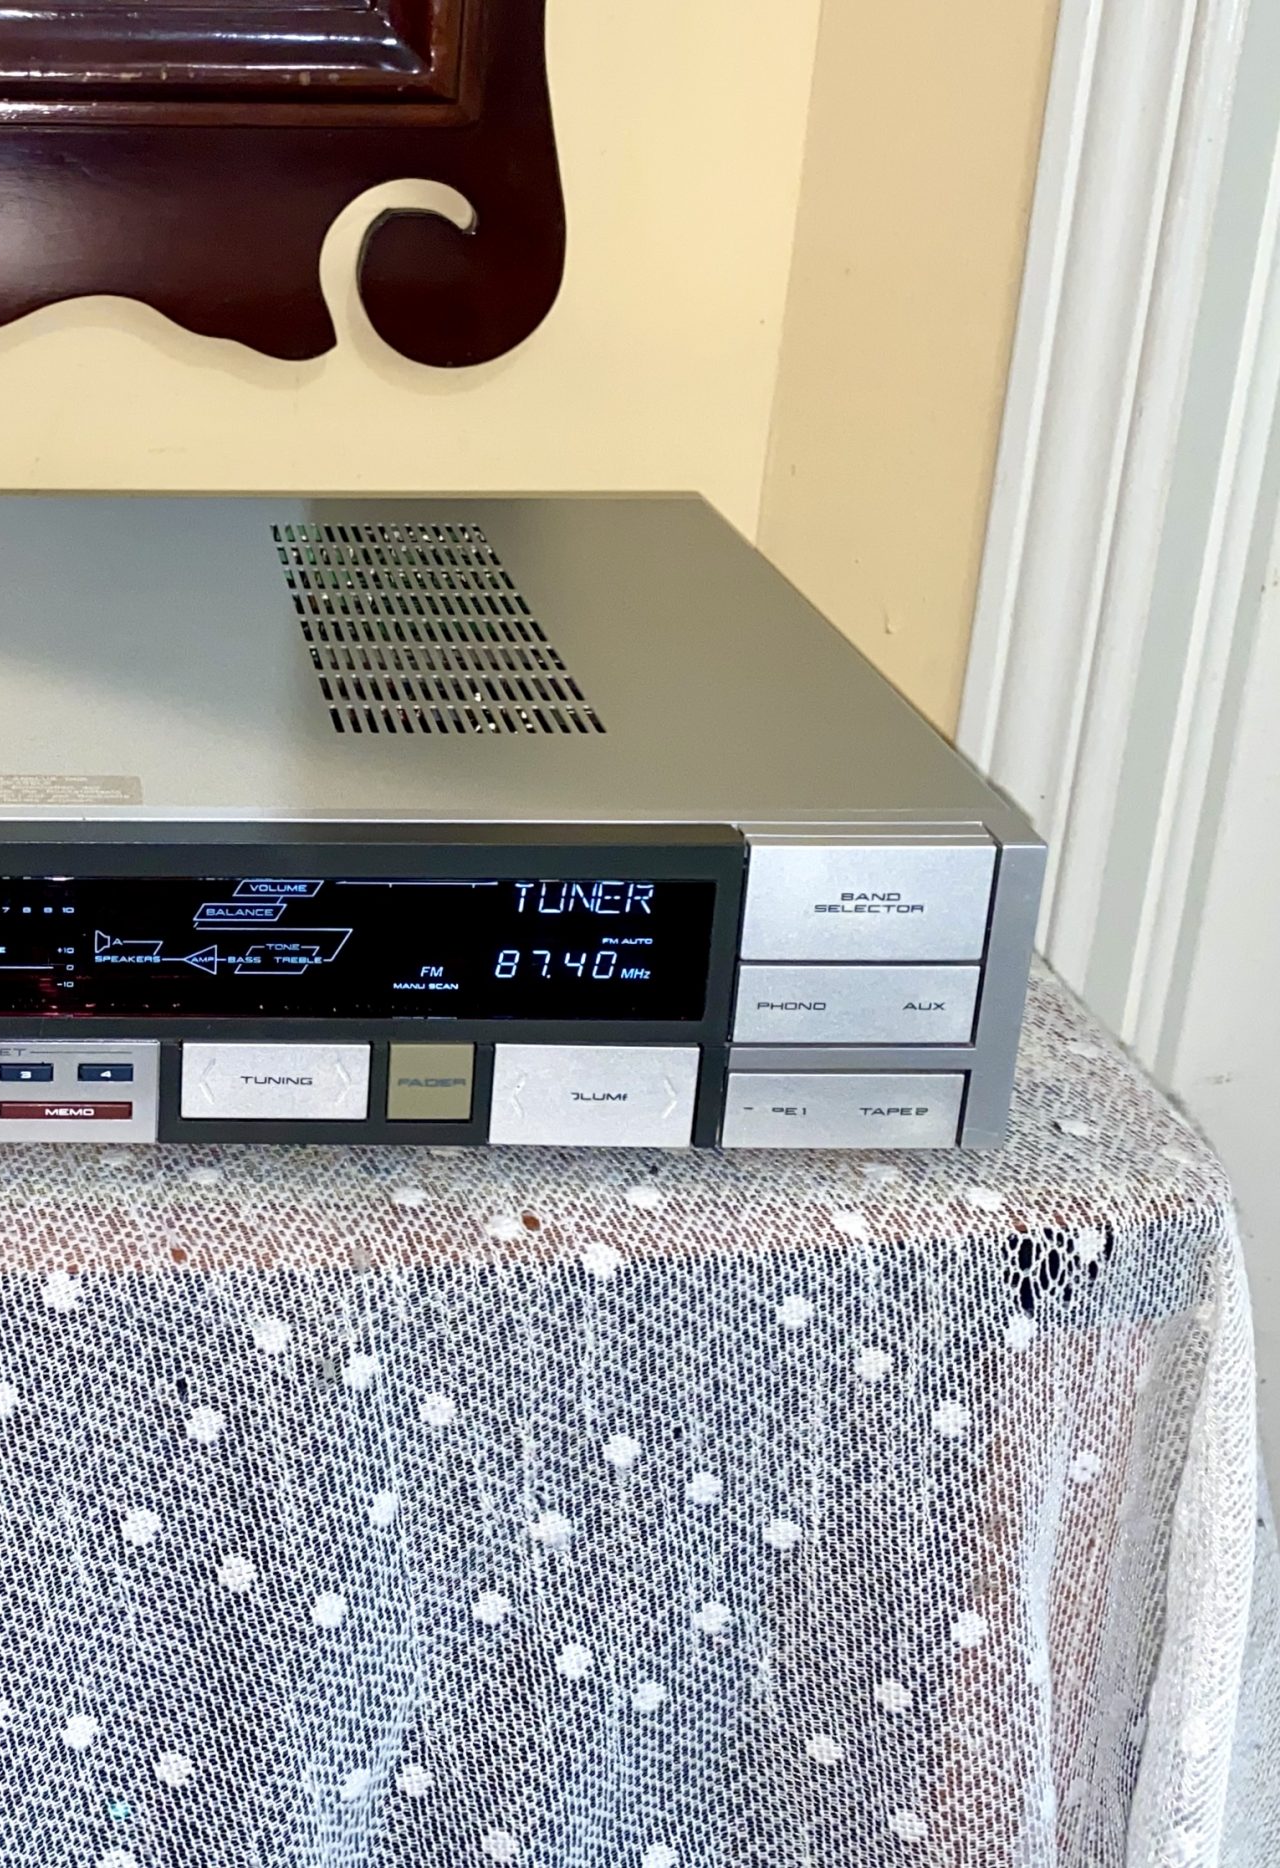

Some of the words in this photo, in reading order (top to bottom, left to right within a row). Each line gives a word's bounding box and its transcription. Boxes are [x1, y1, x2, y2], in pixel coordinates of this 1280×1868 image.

[249, 884, 308, 893] VOLUME
[515, 881, 655, 914] TUNER
[841, 892, 901, 901] BAND
[205, 908, 275, 917] BALANCE
[814, 904, 925, 913] SELECTOR
[112, 938, 123, 946] A
[602, 937, 619, 945] FM
[621, 937, 653, 945] AUTO
[266, 943, 301, 951] TONE
[94, 955, 161, 963] SPEAKERS
[191, 956, 214, 964] AMP
[227, 955, 262, 964] BASS
[274, 956, 323, 964] TREBLE
[495, 950, 618, 979] 87.40
[620, 968, 651, 979] MHz
[420, 966, 444, 978] FM
[757, 1002, 827, 1011] PHONO
[902, 1002, 946, 1011] AUX
[20, 1071, 32, 1079] 3
[99, 1070, 112, 1079] 4
[240, 1076, 313, 1085] TUNING
[397, 1078, 467, 1087] FADER
[45, 1108, 95, 1117] MEMO
